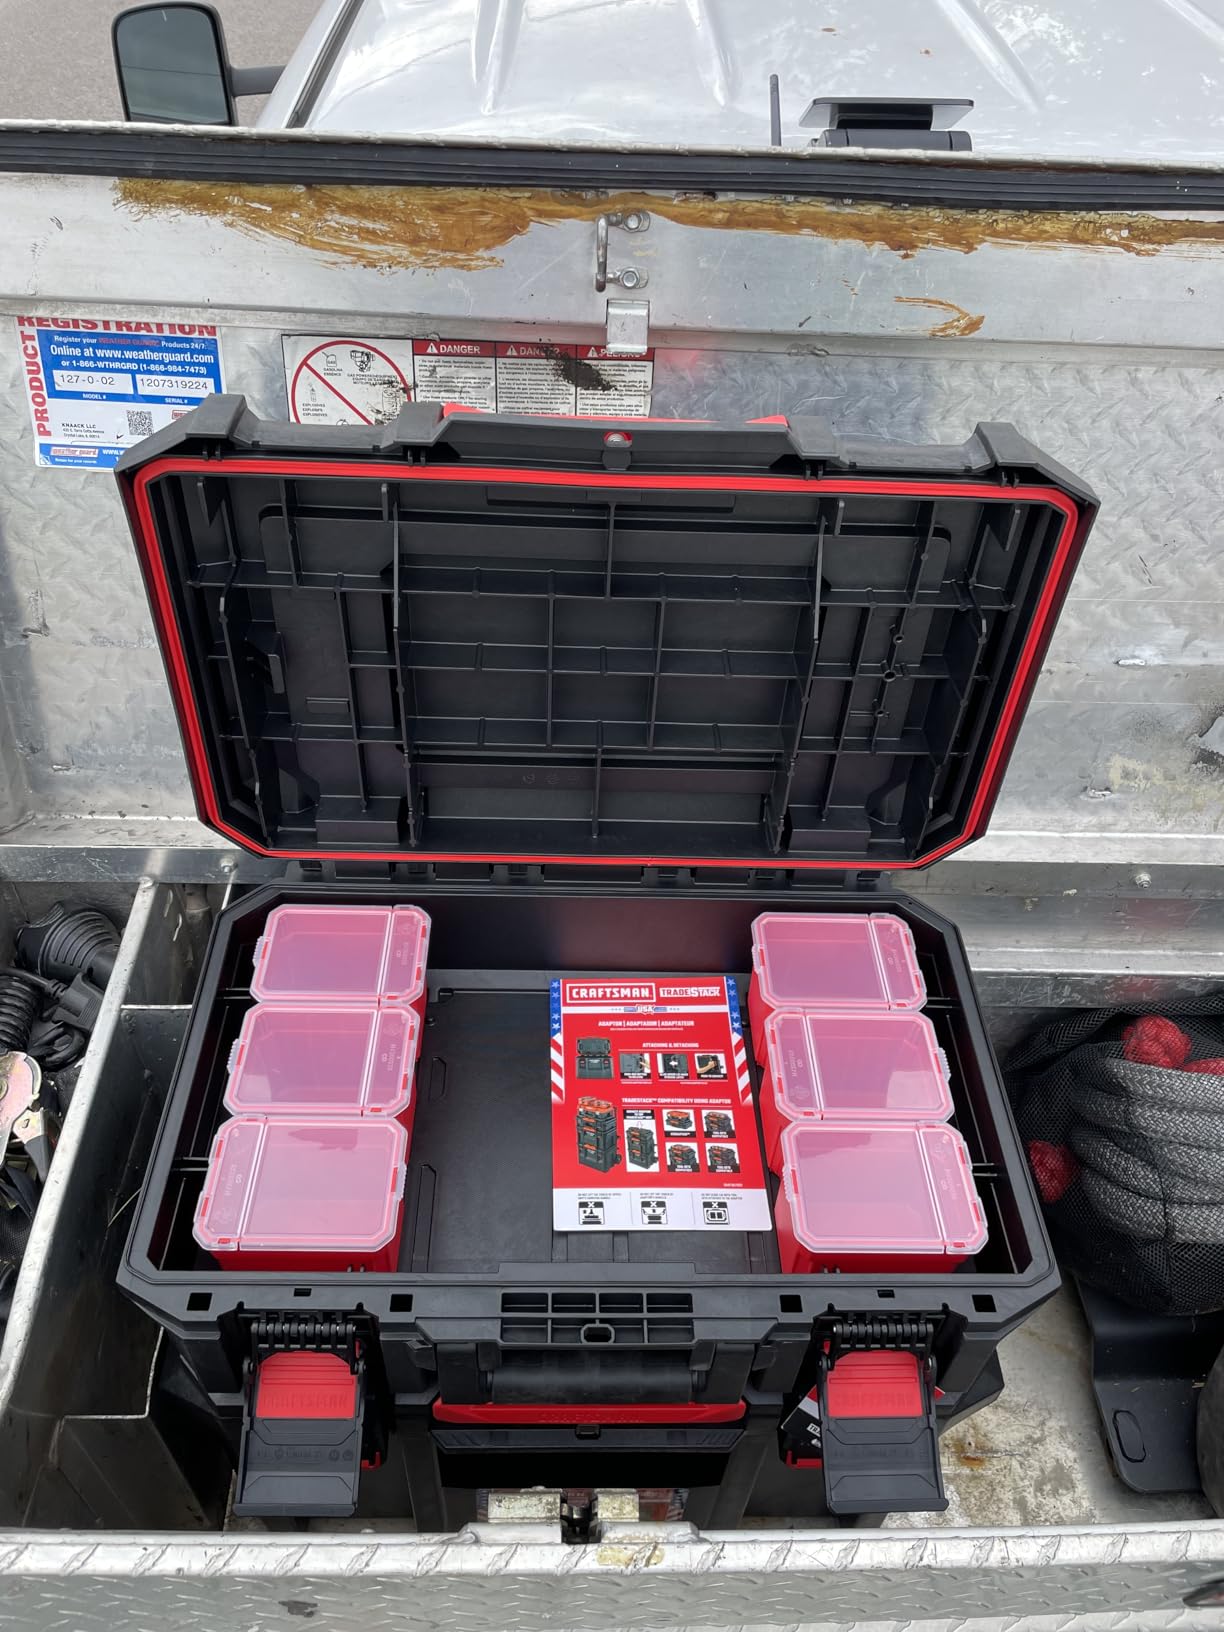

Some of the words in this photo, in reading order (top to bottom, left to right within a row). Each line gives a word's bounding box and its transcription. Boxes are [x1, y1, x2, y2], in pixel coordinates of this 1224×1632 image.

[54, 335, 81, 344] Register
[161, 341, 190, 349] Products
[439, 344, 481, 354] DANGER
[50, 344, 82, 357] Online
[84, 346, 94, 357] at
[96, 349, 214, 363] www.weatherguard.com
[72, 360, 139, 371] 1-866-WTHRGRD
[140, 362, 207, 375] (1-866-984-7473)
[20, 331, 53, 438] PRODUCT
[140, 378, 208, 390] 1207319224
[572, 987, 650, 999] CRAFTSMAN
